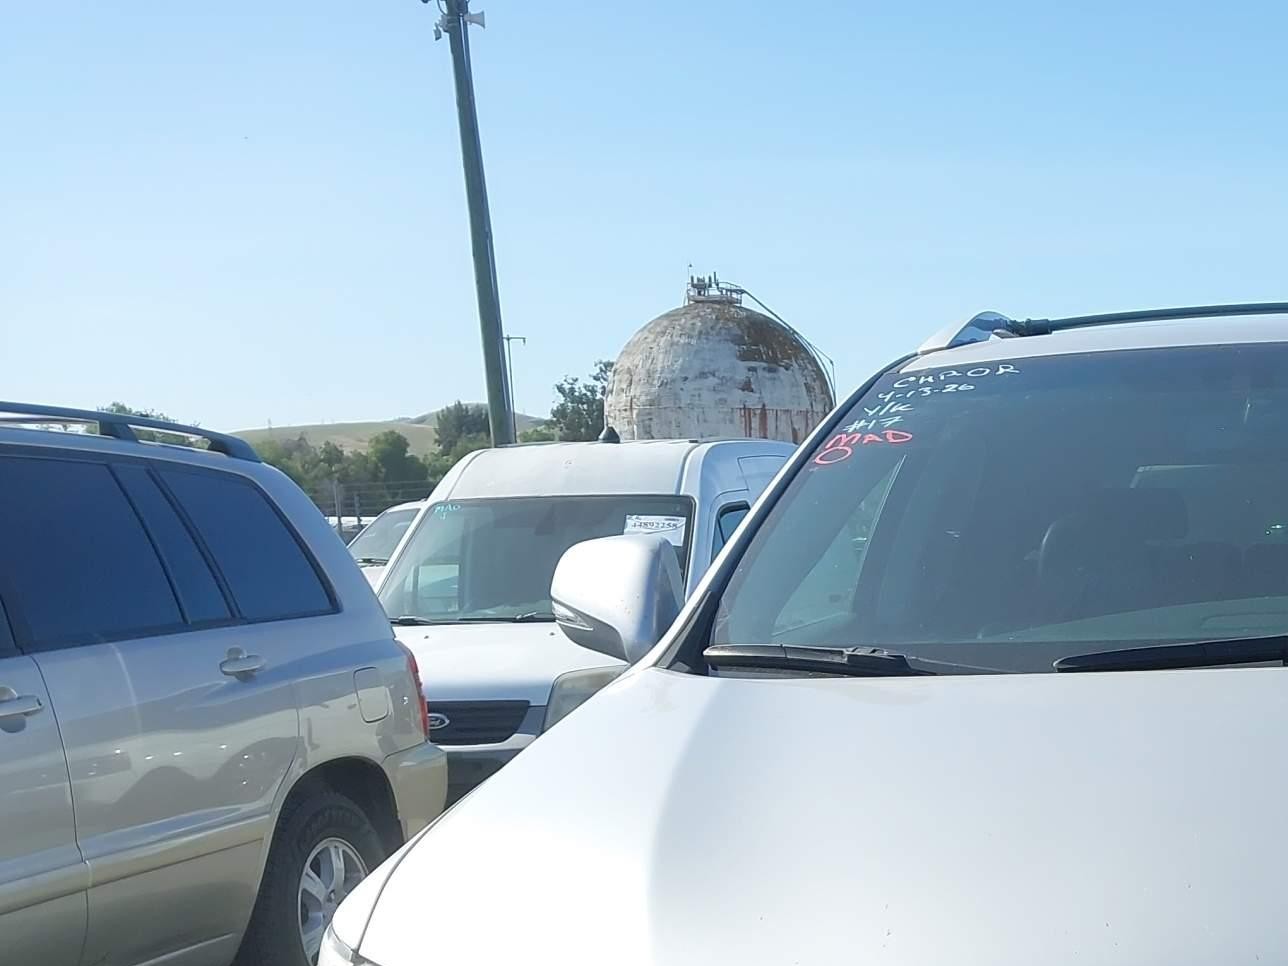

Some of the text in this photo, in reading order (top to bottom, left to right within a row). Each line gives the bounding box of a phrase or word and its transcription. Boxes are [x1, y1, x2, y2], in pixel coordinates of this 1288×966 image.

[878, 383, 976, 402] 4-13-26
[843, 415, 905, 433] #17
[825, 430, 913, 449] MAD
